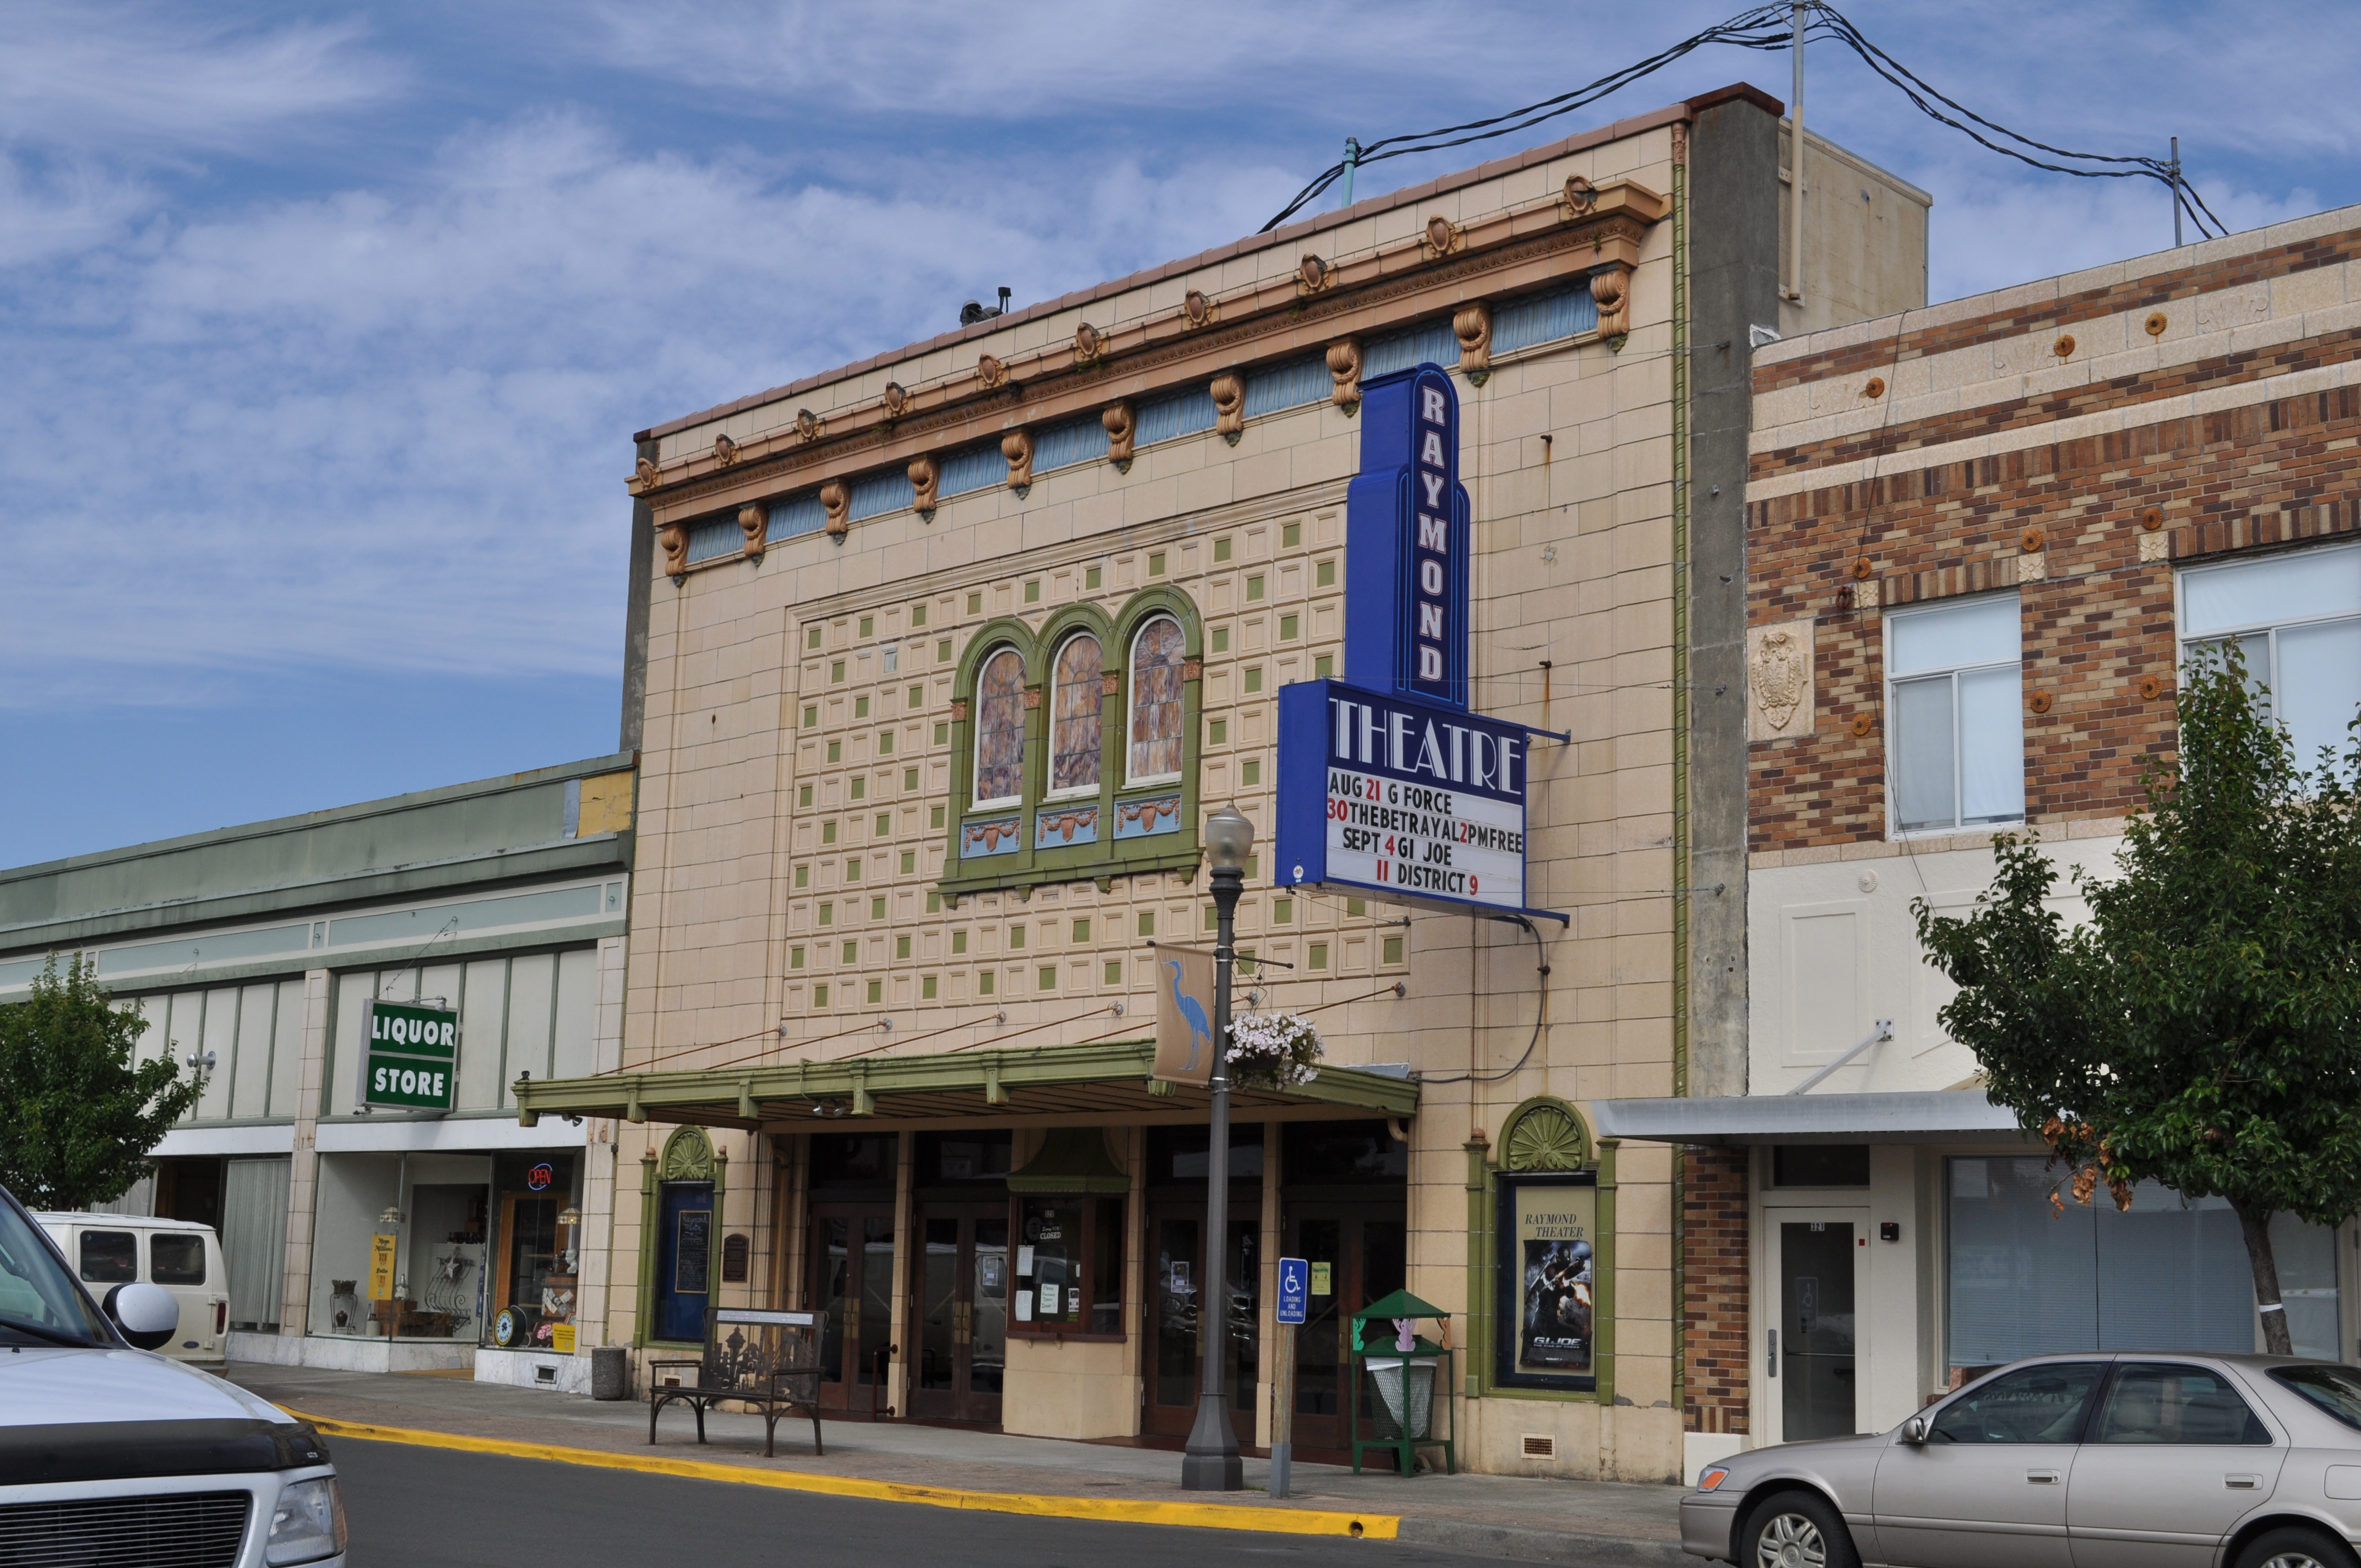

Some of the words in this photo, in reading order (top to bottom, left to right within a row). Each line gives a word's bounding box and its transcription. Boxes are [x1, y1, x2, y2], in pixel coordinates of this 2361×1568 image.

[1419, 385, 1447, 681] RAYMOND
[1329, 697, 1521, 795] THEATRE
[1329, 772, 1362, 798] AUG
[1366, 778, 1380, 801] 21
[1388, 783, 1398, 804] G
[1404, 786, 1452, 815] FORCE
[1327, 798, 1348, 821] 30
[1343, 827, 1380, 853] SEPT
[1385, 835, 1395, 856] 4
[1398, 837, 1413, 859] GI
[1423, 842, 1451, 866] JOE
[1398, 863, 1465, 894] DISTRICT
[1470, 875, 1478, 896] 9
[372, 1015, 454, 1046] LIQUOR
[374, 1067, 444, 1096] STORE
[529, 1169, 551, 1184] OPEN
[1525, 1214, 1576, 1224] RAYMOND
[1536, 1227, 1584, 1237] THEATER
